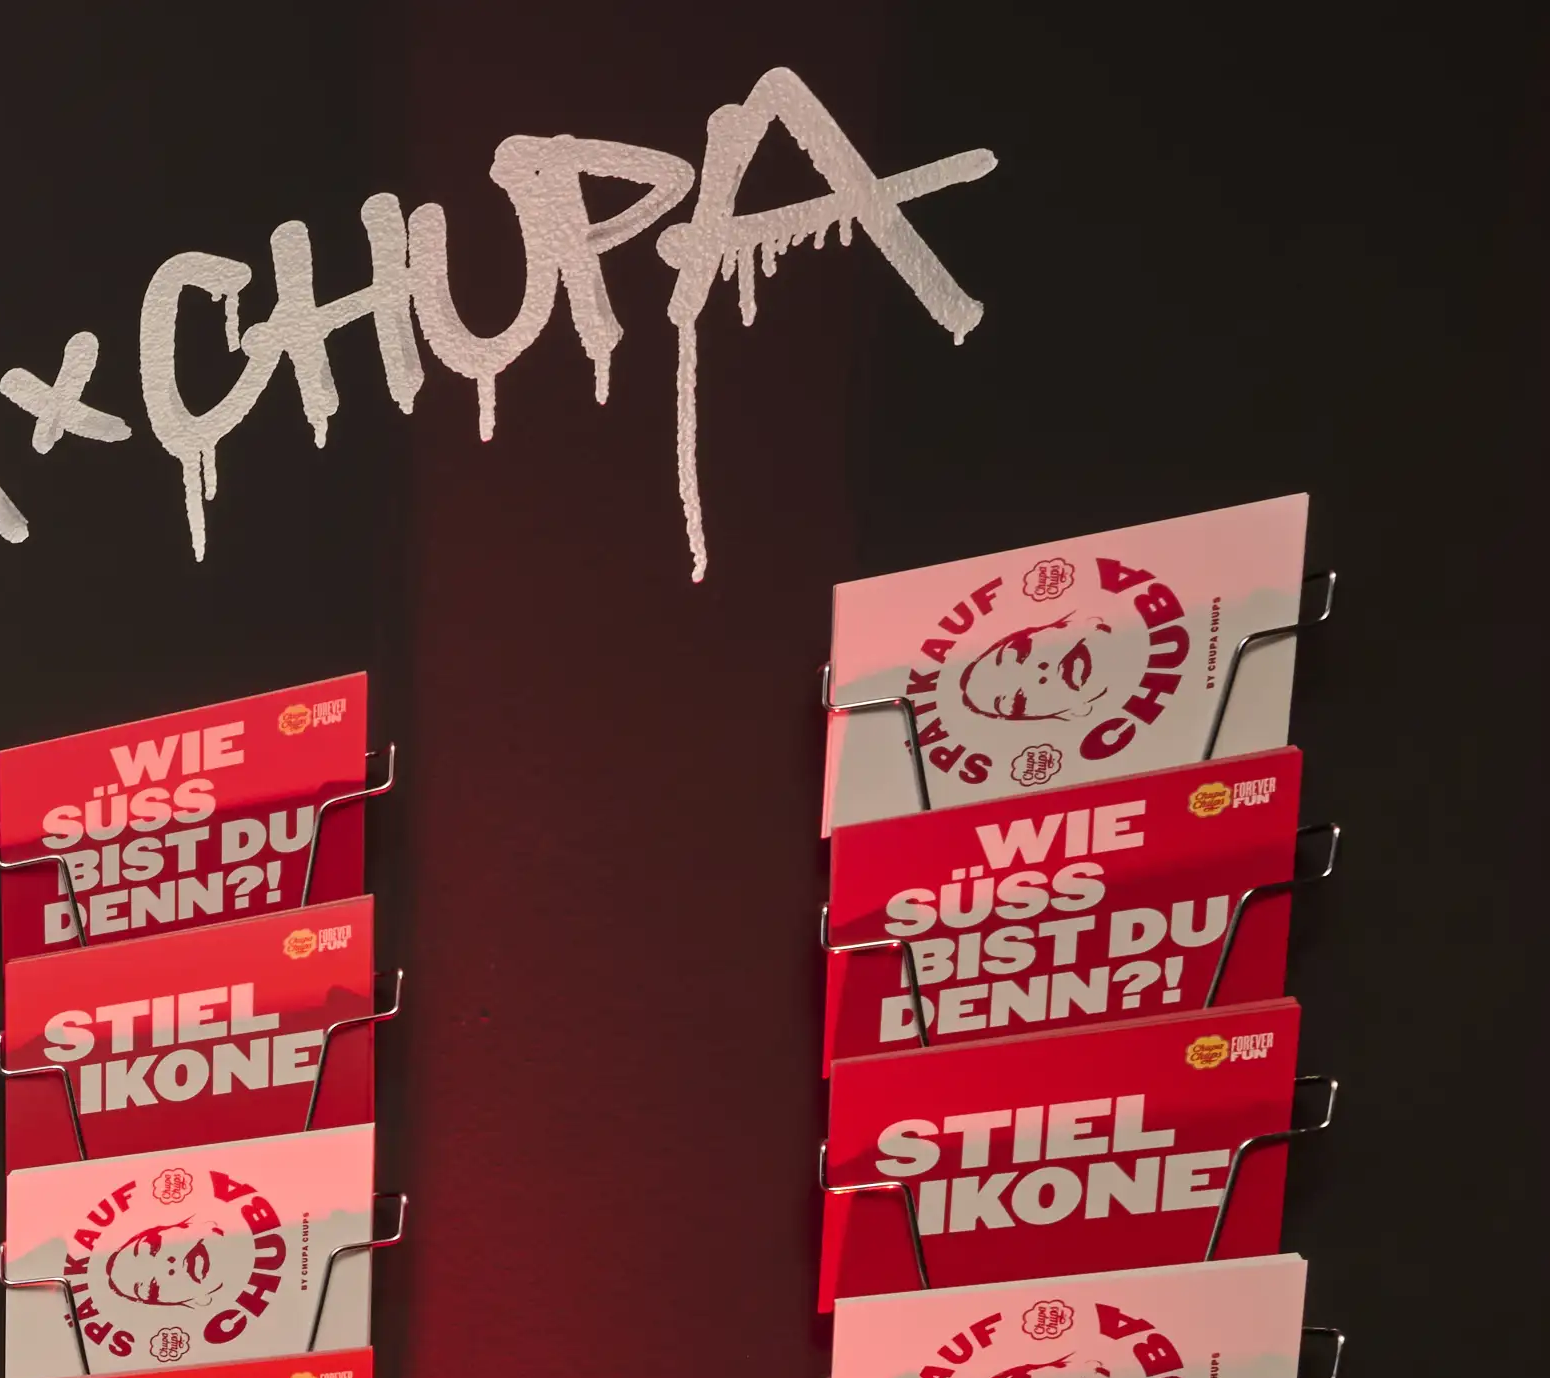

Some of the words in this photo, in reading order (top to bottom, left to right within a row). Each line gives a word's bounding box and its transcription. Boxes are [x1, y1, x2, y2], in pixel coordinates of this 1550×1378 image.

[139, 65, 999, 455] CHUPA
[1208, 636, 1217, 671] CHUPA
[1211, 597, 1221, 633] CHUPS
[1079, 556, 1191, 762] CHUBA
[110, 721, 246, 787] WIE
[1233, 776, 1276, 798] FOREVER
[42, 778, 216, 849] SÜSS
[977, 800, 1147, 870] WIE
[1232, 791, 1270, 808] FUN
[57, 824, 209, 896] BIST
[221, 804, 316, 864] DU
[44, 862, 283, 945] DENN?!
[884, 862, 1105, 936] SÜSS
[901, 915, 1097, 989] BIST
[1109, 895, 1228, 960] DU
[43, 983, 281, 1063] STIEL
[879, 955, 1183, 1042] DENN?!
[79, 1029, 324, 1116] IKONE
[875, 1093, 1176, 1178] STIEL
[918, 1149, 1233, 1237] IKONE
